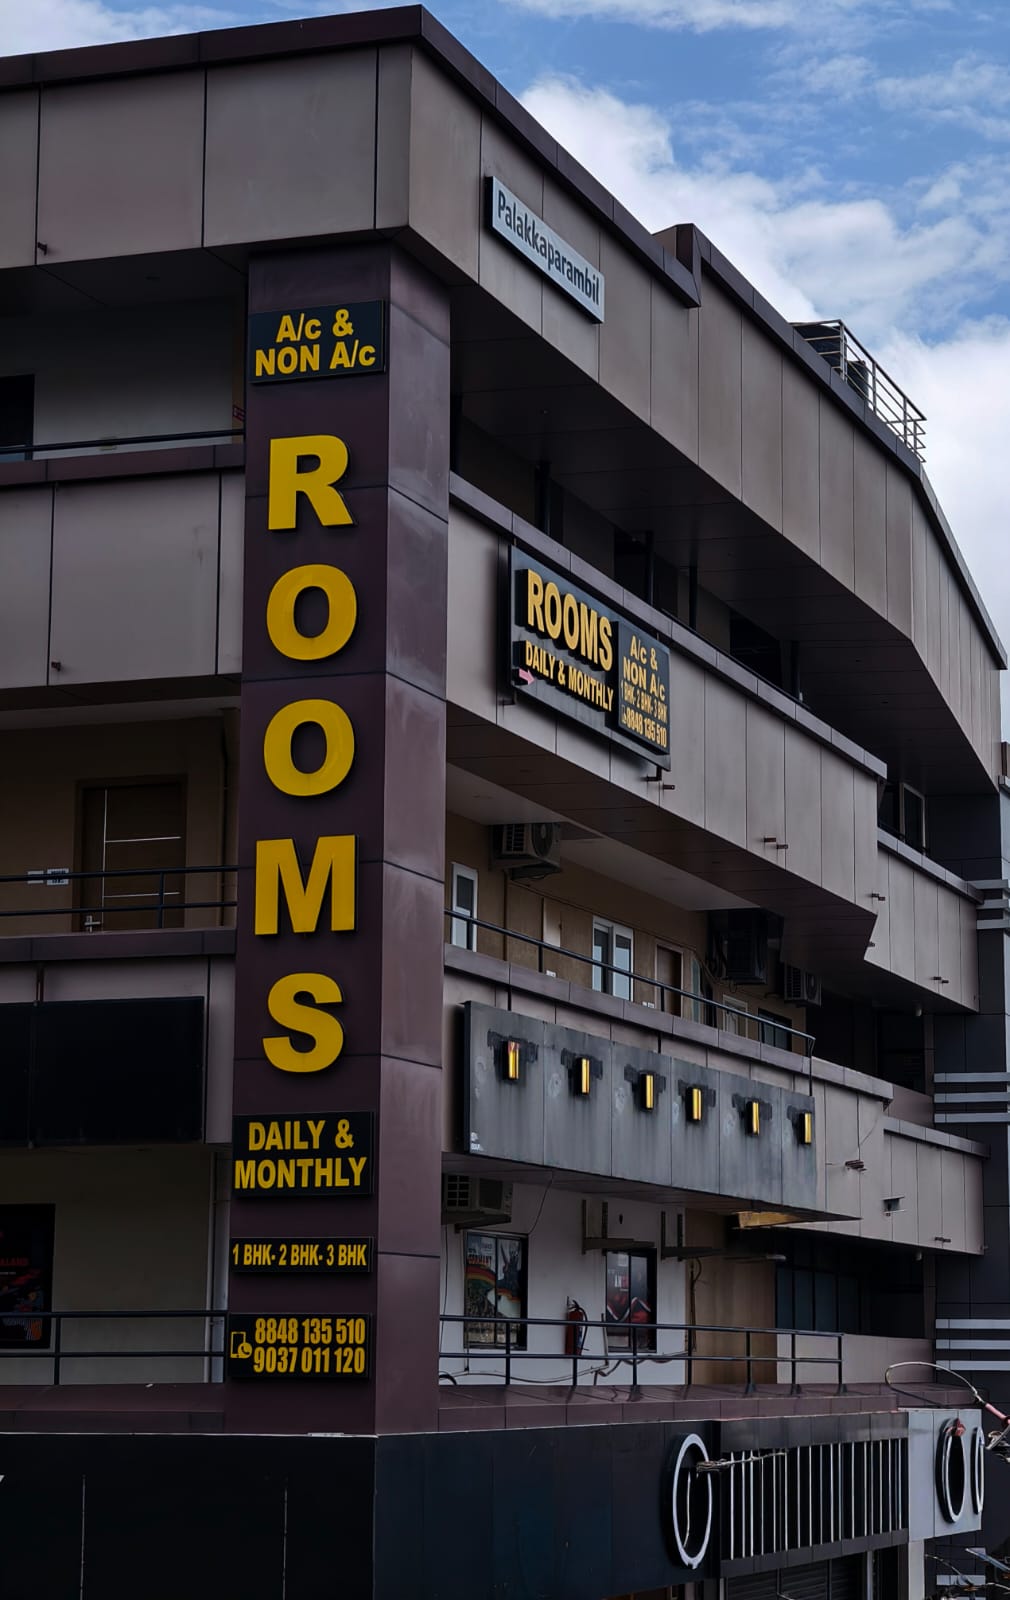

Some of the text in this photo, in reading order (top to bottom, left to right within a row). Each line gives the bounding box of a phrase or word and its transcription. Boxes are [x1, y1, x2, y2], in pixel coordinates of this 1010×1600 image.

[497, 189, 600, 306] Palakkaparambil
[275, 308, 354, 343] A/c &
[255, 339, 376, 377] NON A/c
[527, 568, 613, 672] ROOMS
[630, 635, 658, 671] A/c &
[525, 640, 614, 712] DAILY & MONTHLY
[623, 656, 665, 701] NON A/c
[254, 434, 358, 1073] ROOMS
[248, 1118, 354, 1151] DAILY &
[234, 1157, 367, 1189] MONTHLY
[232, 1243, 239, 1266] 1
[278, 1244, 287, 1266] 2
[326, 1244, 334, 1266] 3
[338, 1244, 367, 1266] BHK
[255, 1317, 366, 1345] 8848 135 510
[253, 1347, 365, 1374] 9037 011 120
